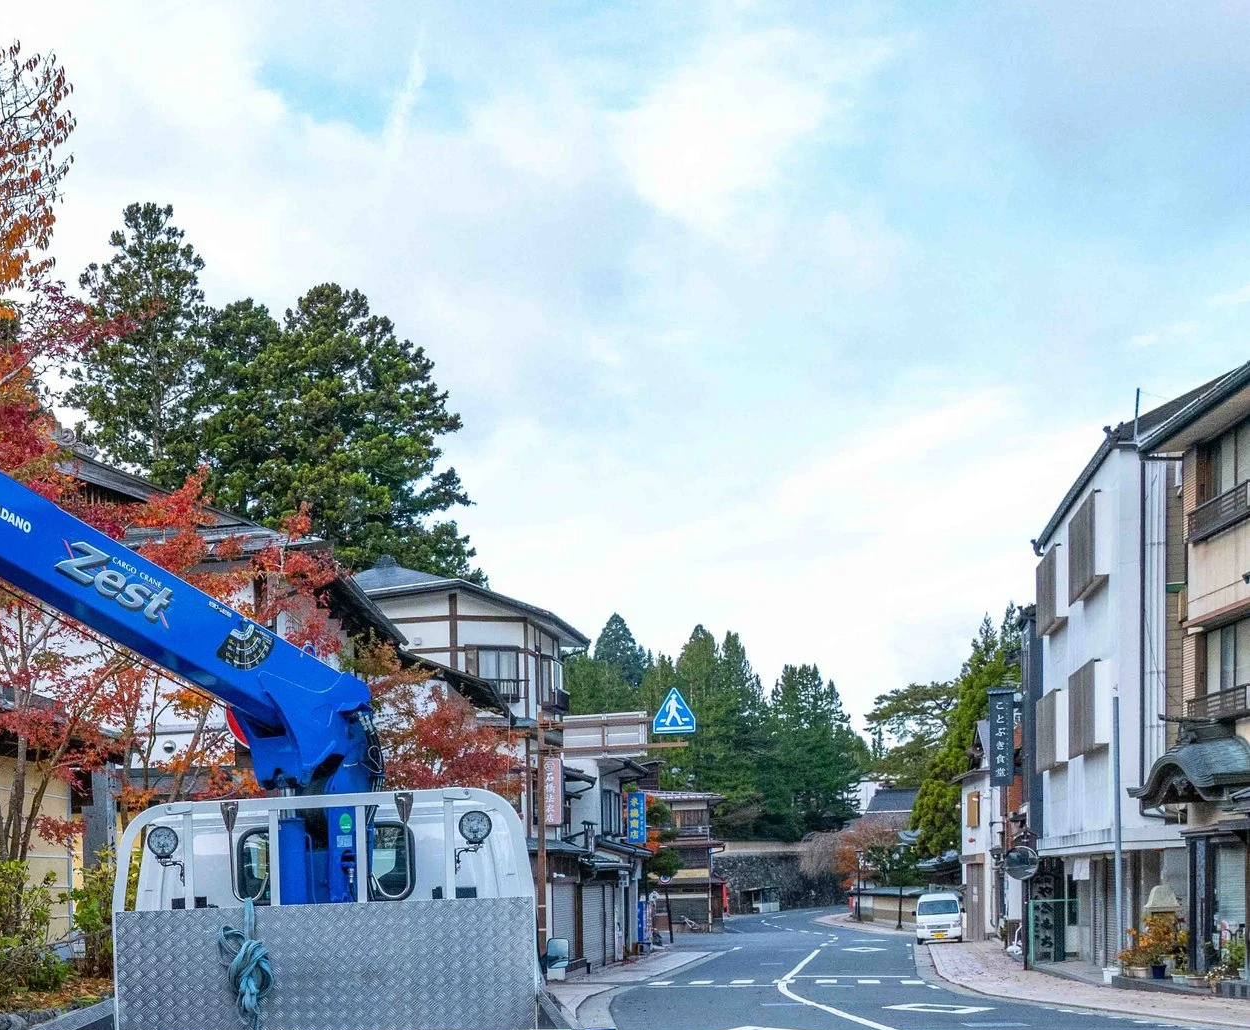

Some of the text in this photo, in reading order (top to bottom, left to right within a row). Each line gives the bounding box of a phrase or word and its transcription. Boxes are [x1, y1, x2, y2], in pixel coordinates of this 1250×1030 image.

[54, 541, 174, 624] Zest
[112, 555, 163, 589] CARGO CRANE
[995, 701, 1006, 777] ことぶき食堂
